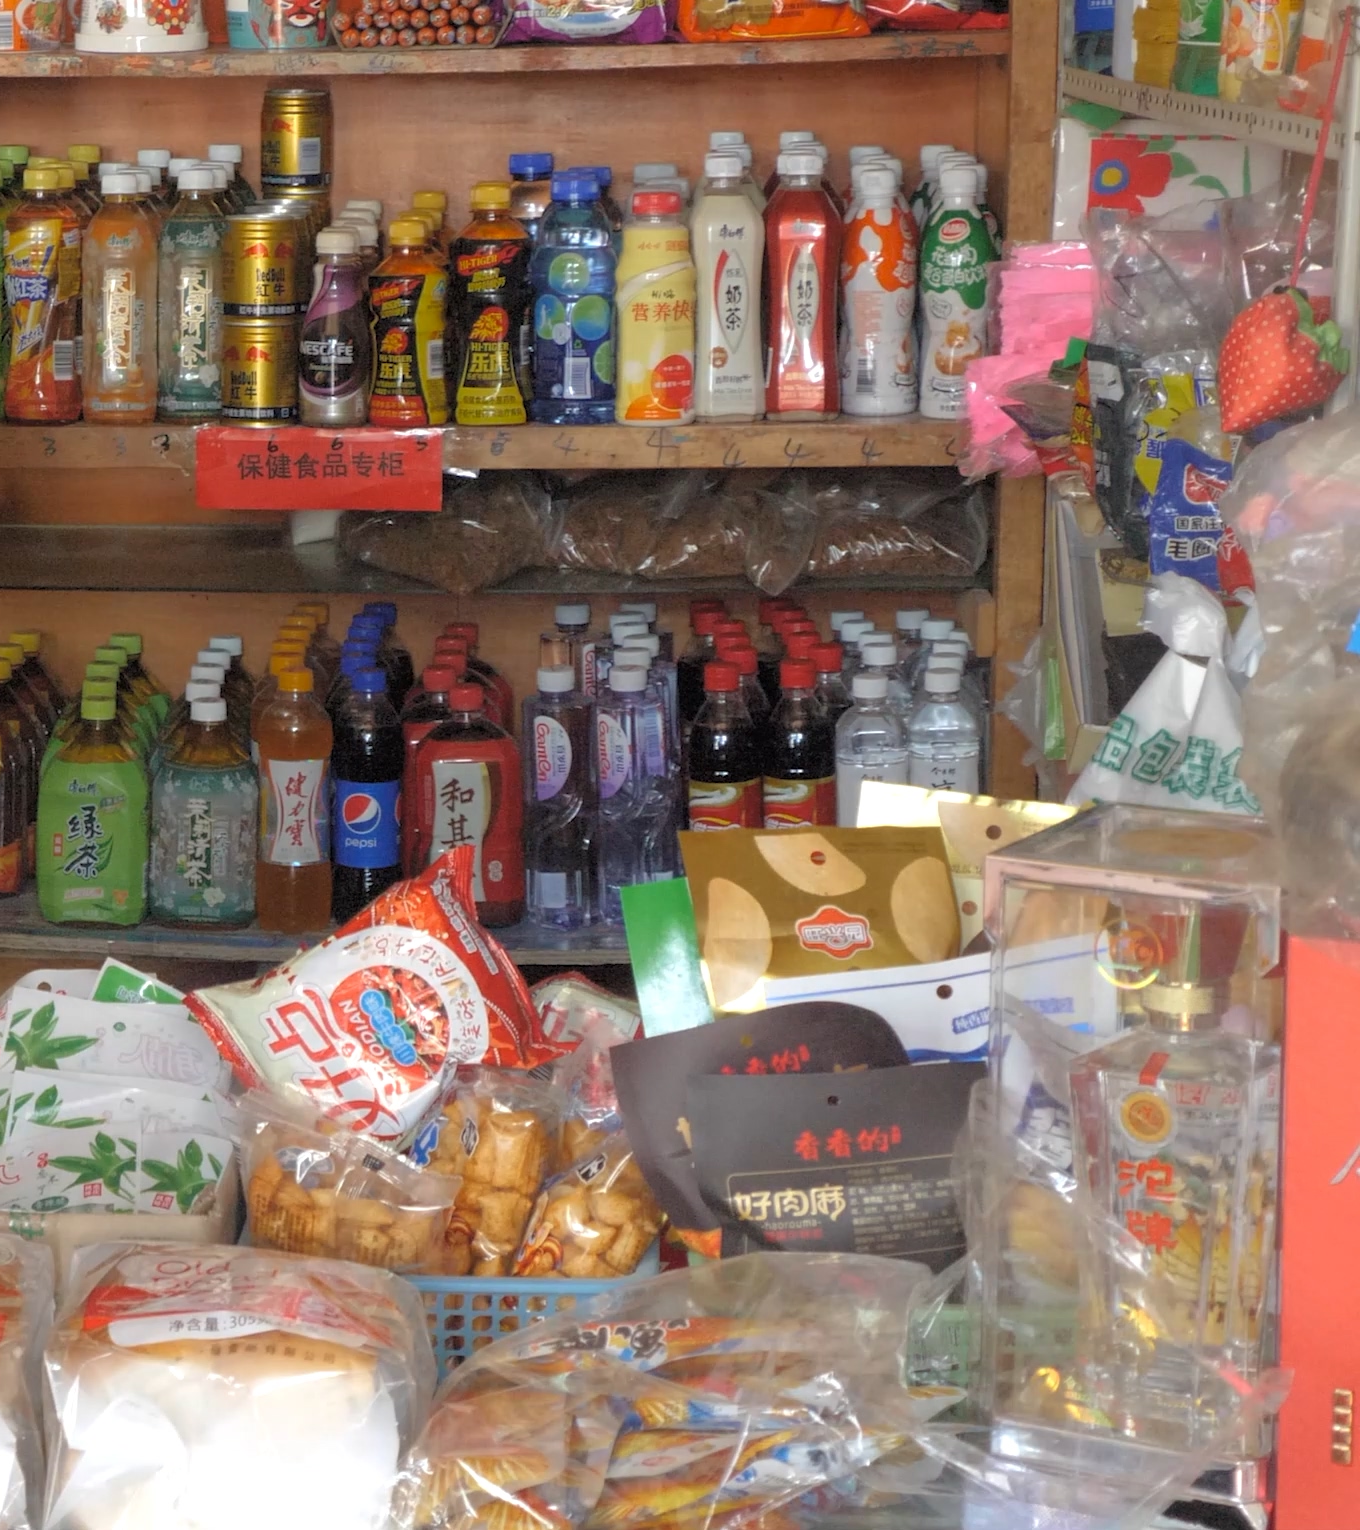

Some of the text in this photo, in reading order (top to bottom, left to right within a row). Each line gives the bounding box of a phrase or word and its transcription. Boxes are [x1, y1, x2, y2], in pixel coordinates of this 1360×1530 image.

[631, 301, 696, 323] 营养快
[725, 284, 743, 332] 奶茶
[796, 279, 814, 327] 奶茶
[237, 452, 406, 480] 保健食品专柜
[63, 803, 103, 880] 绿茶
[345, 836, 378, 850] pepsi
[733, 1184, 847, 1222] 好肉麻
[156, 1259, 232, 1276] Old
